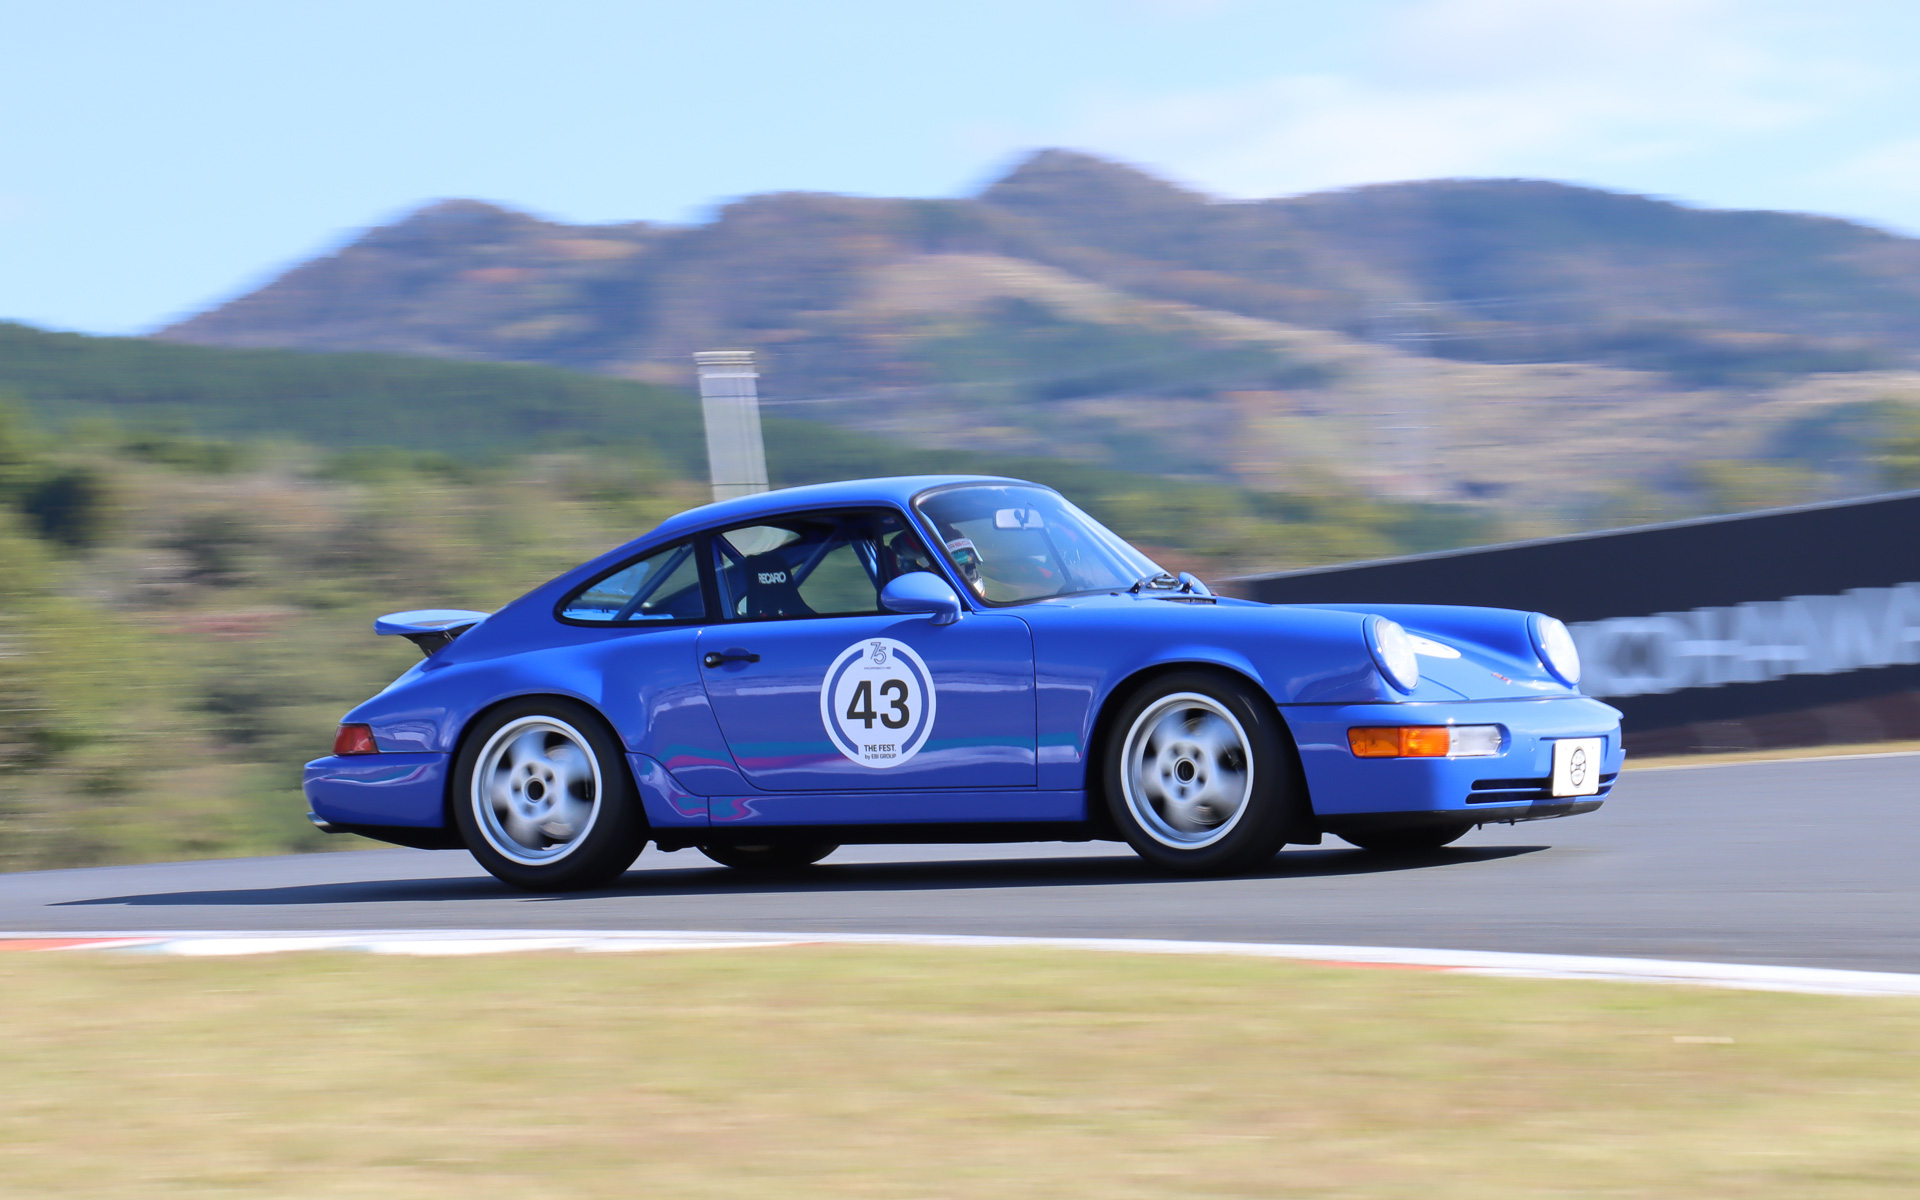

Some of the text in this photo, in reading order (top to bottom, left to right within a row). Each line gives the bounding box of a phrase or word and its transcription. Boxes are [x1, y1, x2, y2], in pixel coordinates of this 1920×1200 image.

[758, 571, 787, 584] RECARO
[870, 641, 887, 665] 75
[846, 678, 910, 729] 43
[863, 744, 878, 752] THE
